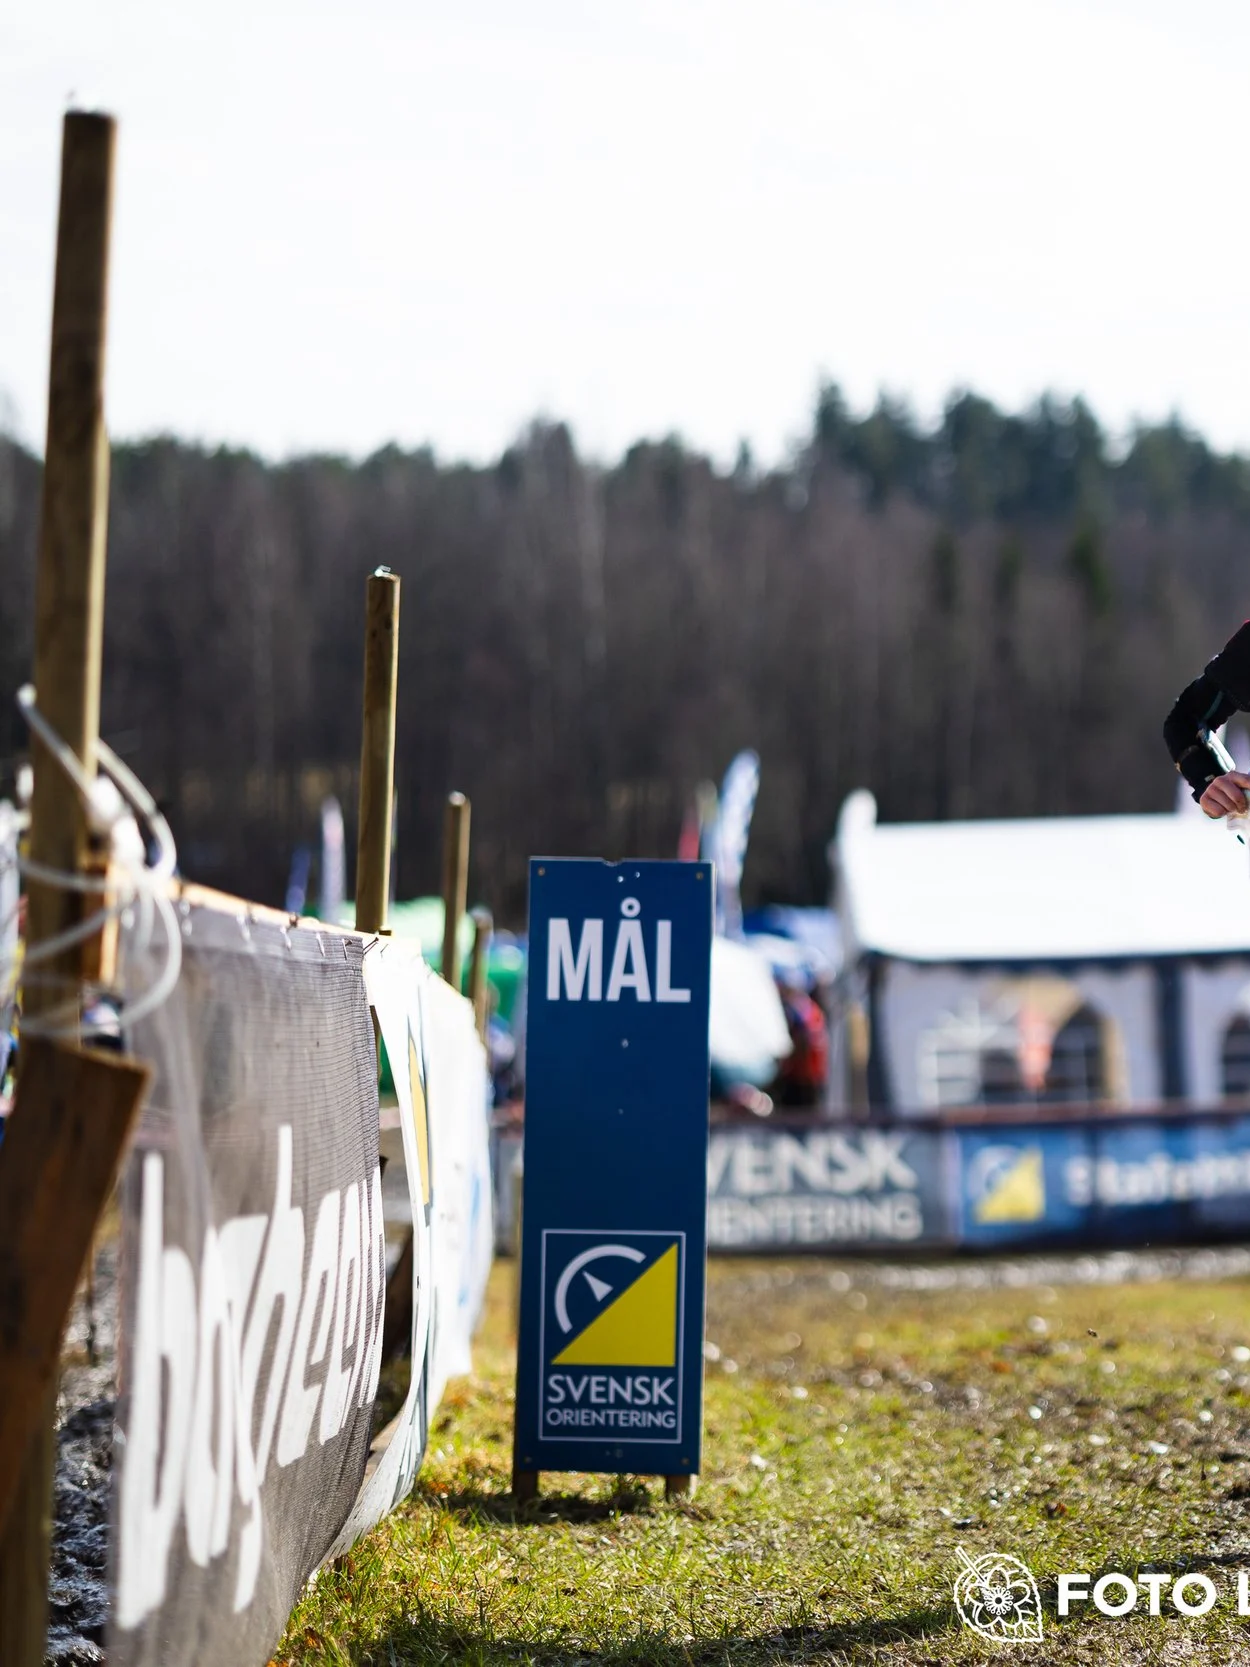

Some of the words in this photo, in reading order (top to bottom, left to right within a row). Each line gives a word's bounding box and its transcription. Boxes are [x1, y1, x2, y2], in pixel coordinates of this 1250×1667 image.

[547, 896, 691, 1003] MÅL
[548, 1373, 675, 1405] SVENSK
[546, 1408, 676, 1428] ORIENTERING
